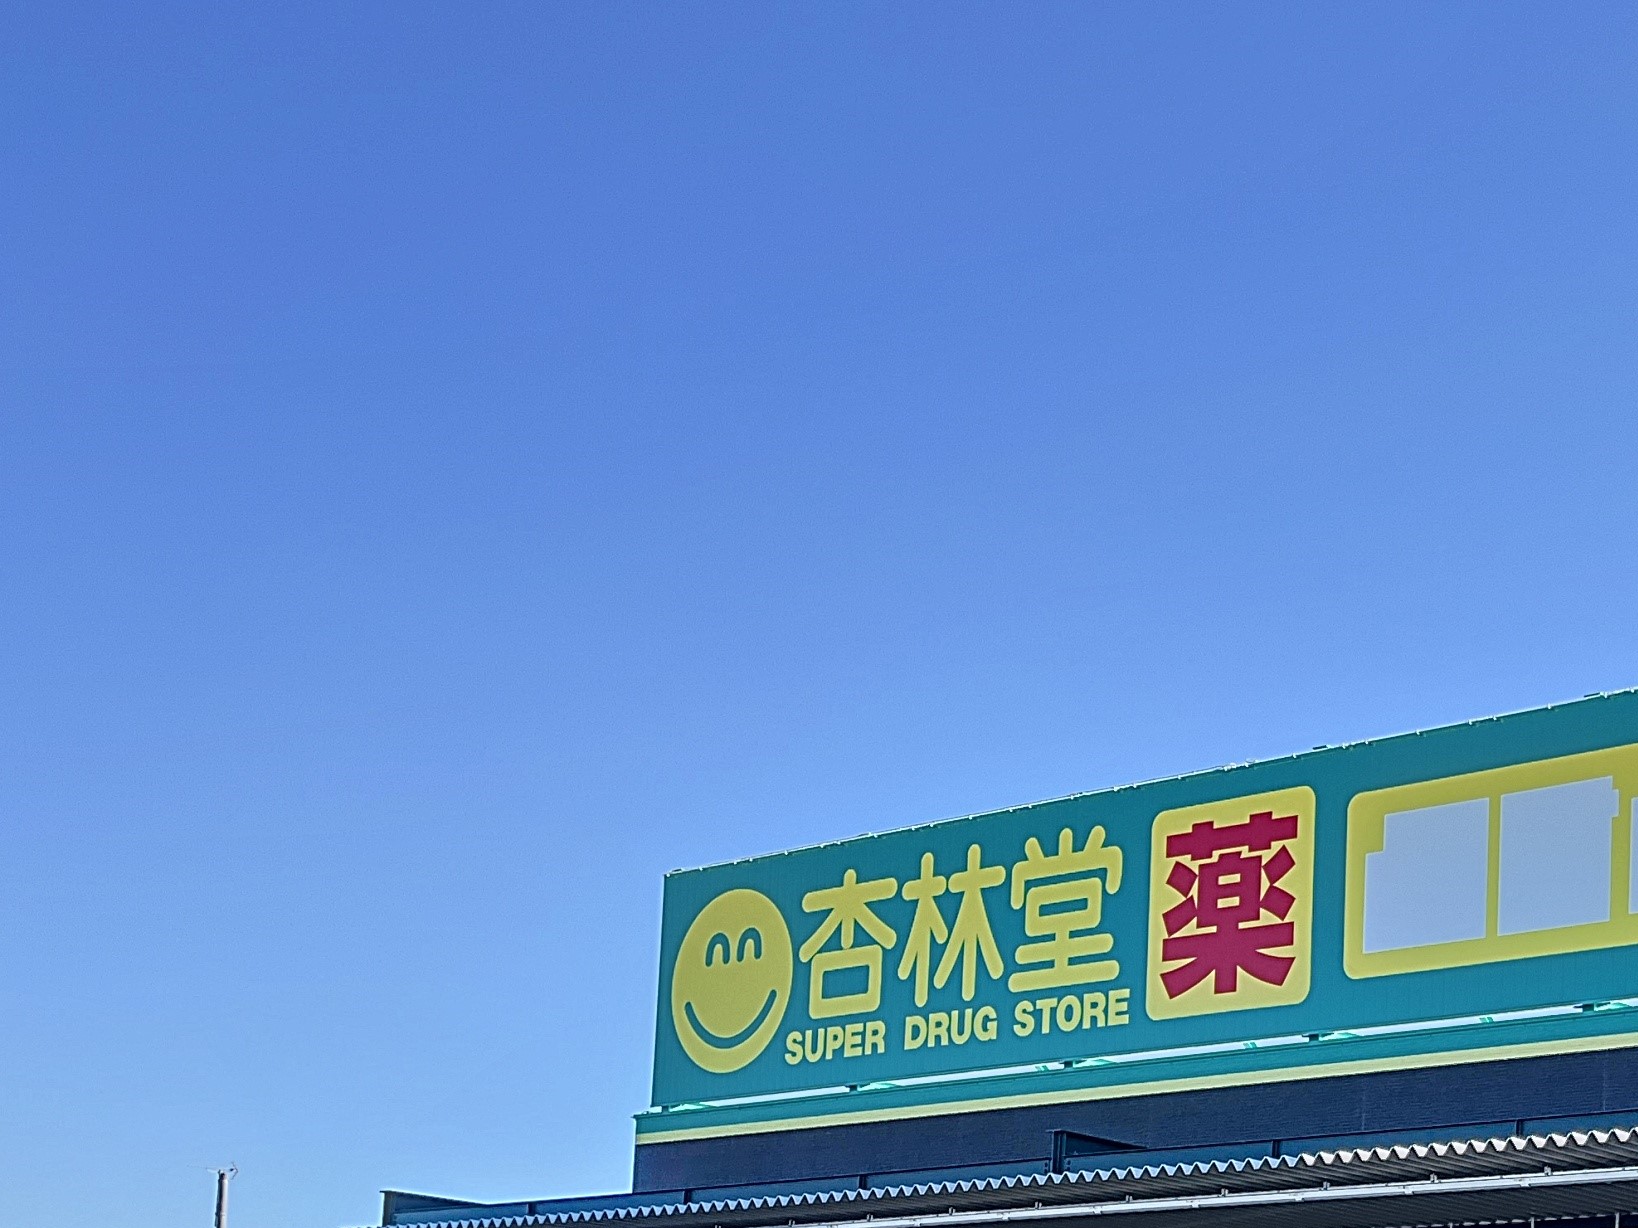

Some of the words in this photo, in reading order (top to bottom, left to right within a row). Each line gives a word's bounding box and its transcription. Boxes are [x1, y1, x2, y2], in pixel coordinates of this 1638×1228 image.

[799, 825, 1123, 1020] 杏林堂
[1160, 811, 1299, 999] 薬
[784, 1020, 886, 1066] SUPER
[904, 1004, 998, 1050] DRUG
[1013, 988, 1131, 1038] STORE
